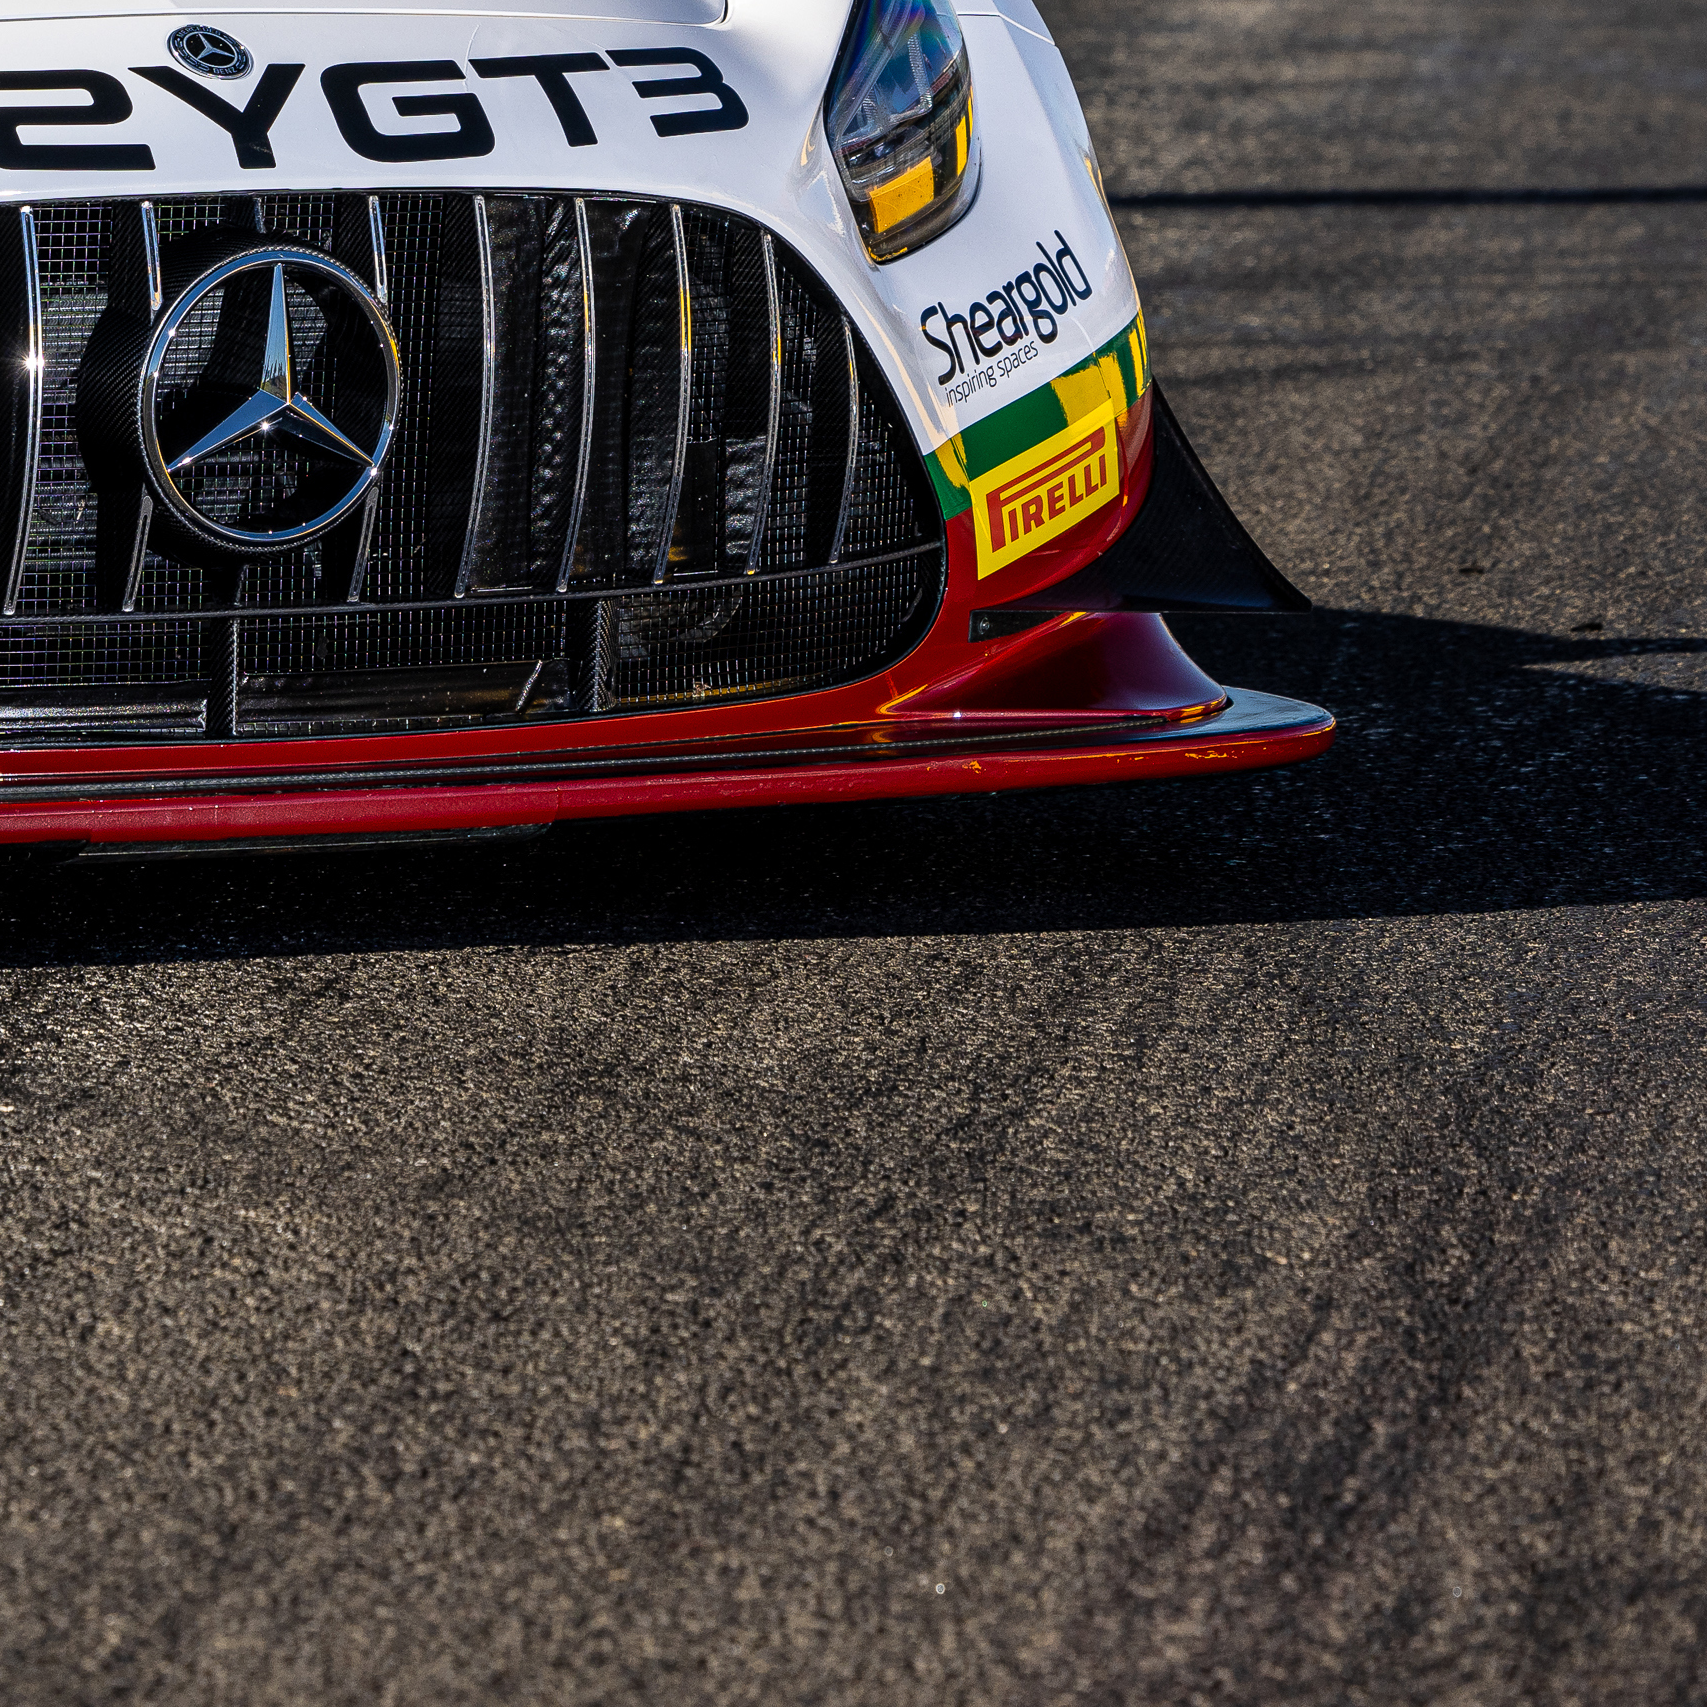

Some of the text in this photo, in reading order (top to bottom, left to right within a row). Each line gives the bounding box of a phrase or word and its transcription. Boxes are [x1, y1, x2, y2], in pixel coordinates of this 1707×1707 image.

[920, 230, 1093, 386] Sheargold
[944, 341, 1039, 408] inspiring spaces
[987, 425, 1107, 553] PIRELLI
